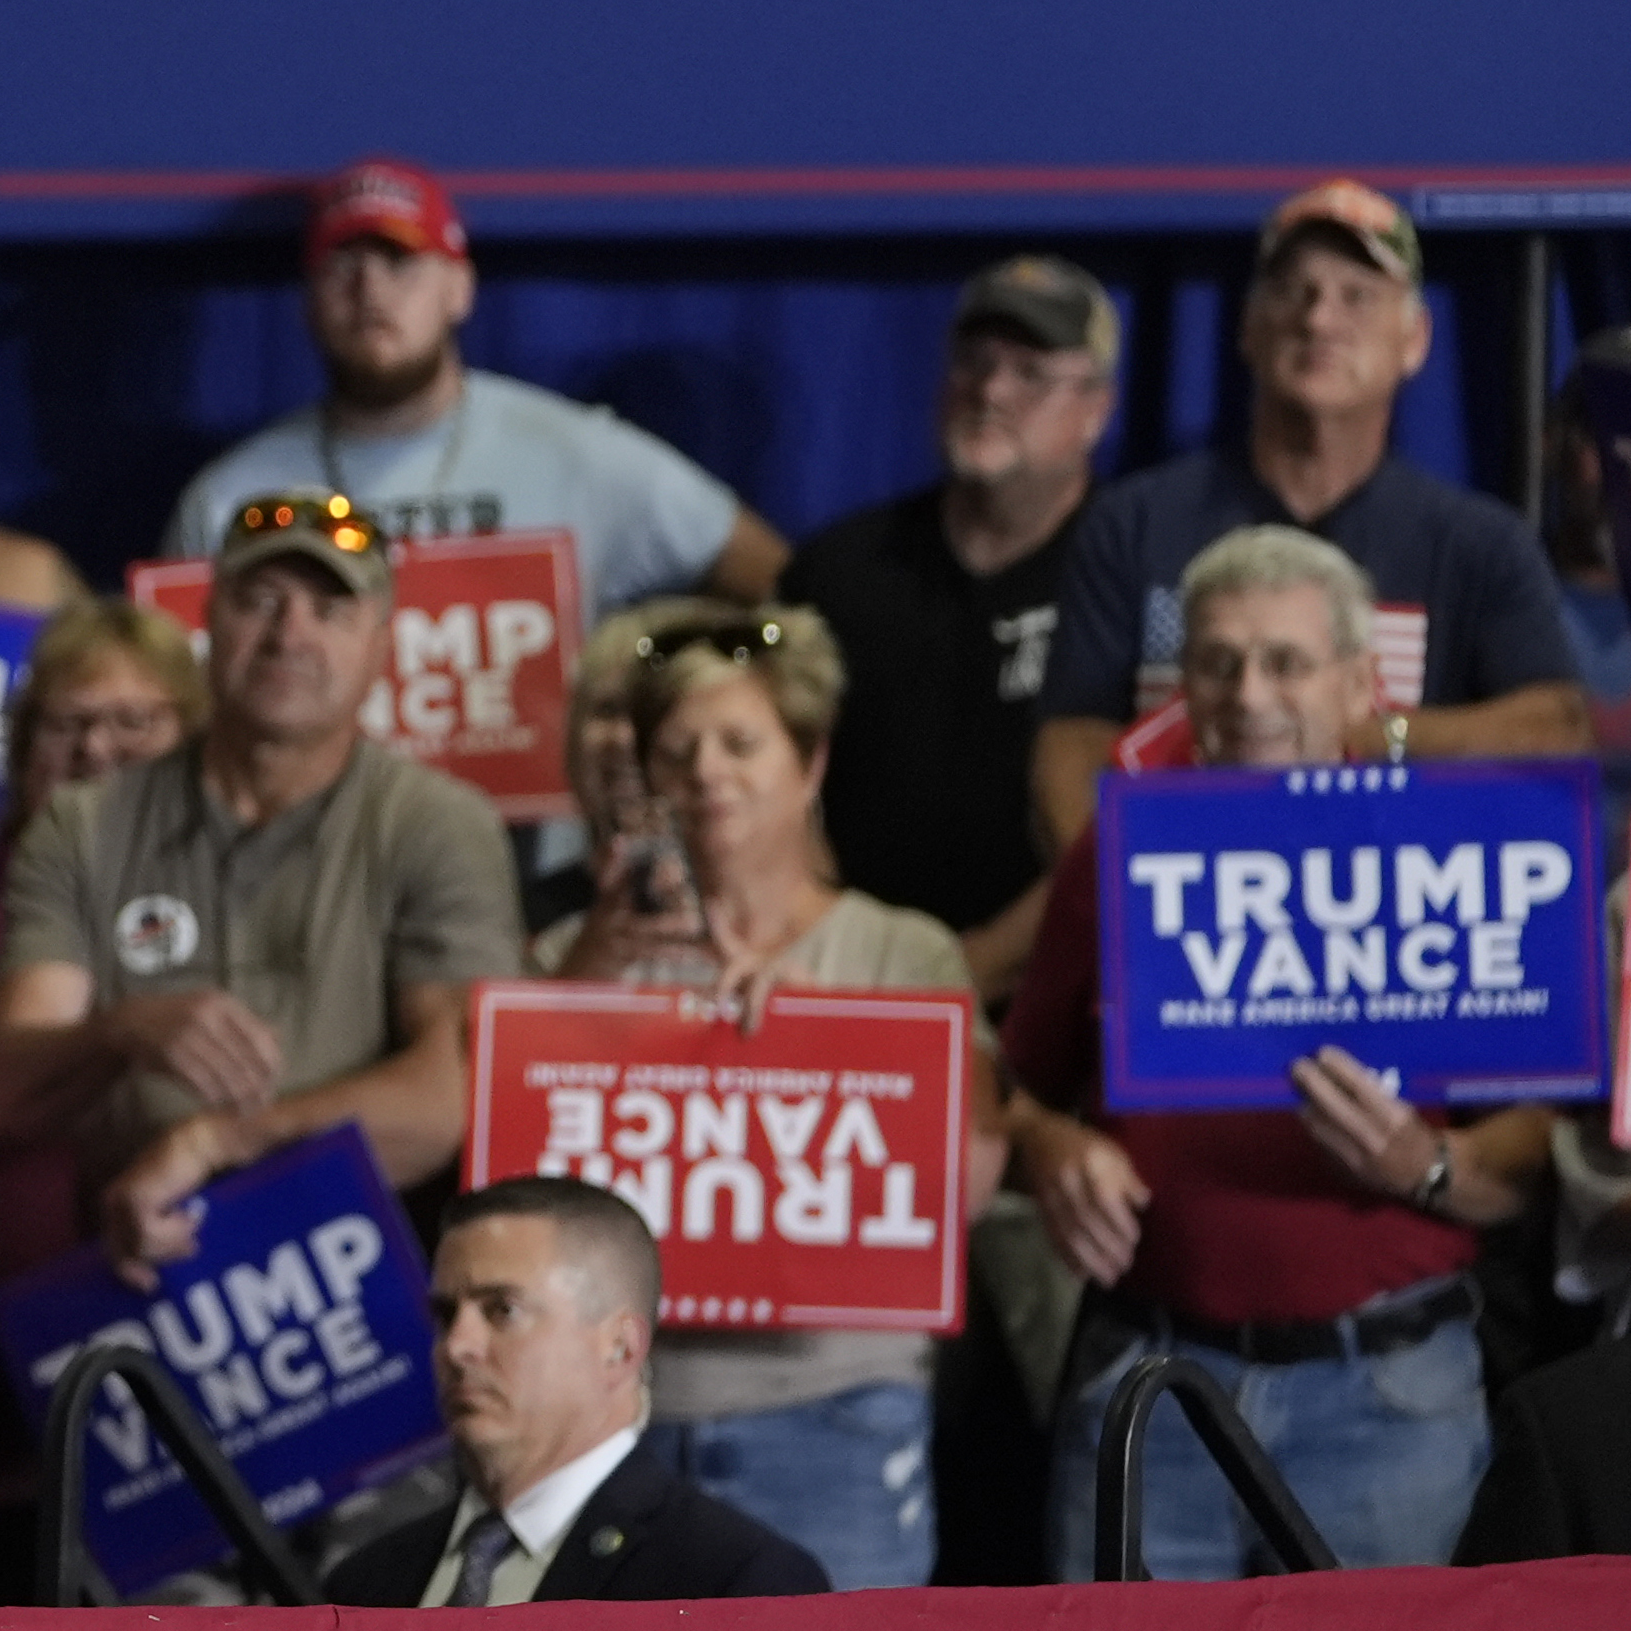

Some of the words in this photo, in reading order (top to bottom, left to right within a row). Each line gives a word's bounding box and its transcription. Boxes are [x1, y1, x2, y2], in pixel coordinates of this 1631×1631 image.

[1127, 839, 1574, 938] TRUMP
[1181, 920, 1527, 999] VANCE
[545, 1086, 890, 1168] VANCE
